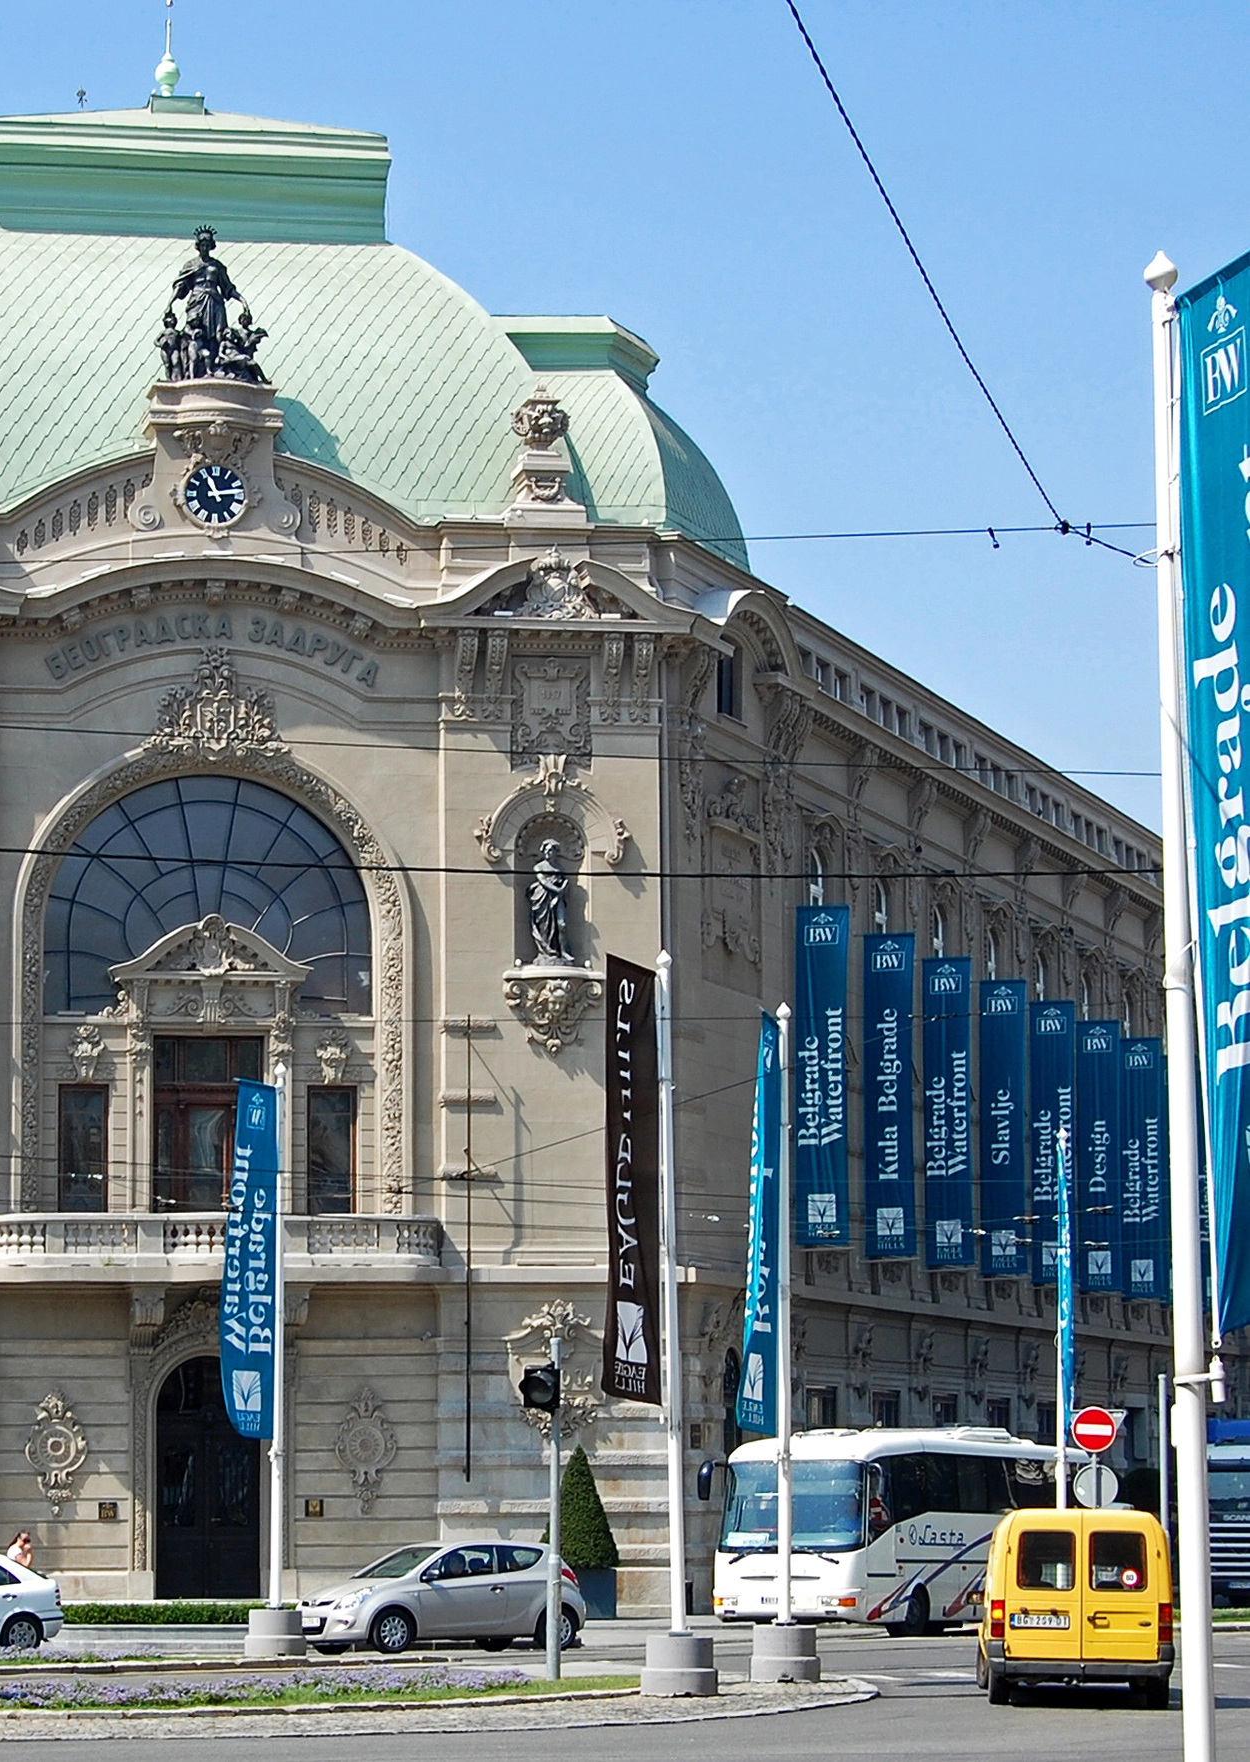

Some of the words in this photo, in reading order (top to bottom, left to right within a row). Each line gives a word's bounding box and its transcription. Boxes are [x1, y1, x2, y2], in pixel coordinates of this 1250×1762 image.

[1205, 338, 1241, 403] BW
[45, 612, 233, 680] БЕОГРАДСКА
[249, 618, 380, 688] ЗАДРУГА
[809, 926, 835, 943] BW
[876, 953, 902, 969] BW
[935, 977, 959, 992] BW
[992, 997, 1015, 1012] BW
[878, 1007, 902, 1112] Belgrade
[1040, 1018, 1063, 1032] BW
[1086, 1036, 1109, 1050] BW
[1128, 1053, 1150, 1067] BW
[798, 1035, 823, 1147] Belgrade
[821, 1007, 843, 1147] Waterfront
[948, 1050, 967, 1177] Waterfront
[879, 1125, 898, 1180] Kula
[926, 1076, 948, 1178] Belgrade
[991, 1088, 1015, 1165] Slavlje
[1033, 1109, 1055, 1202] Belgrade
[1088, 1119, 1110, 1194] Design
[1123, 1138, 1141, 1223] Belgrade
[1142, 1117, 1159, 1223] Waterfront
